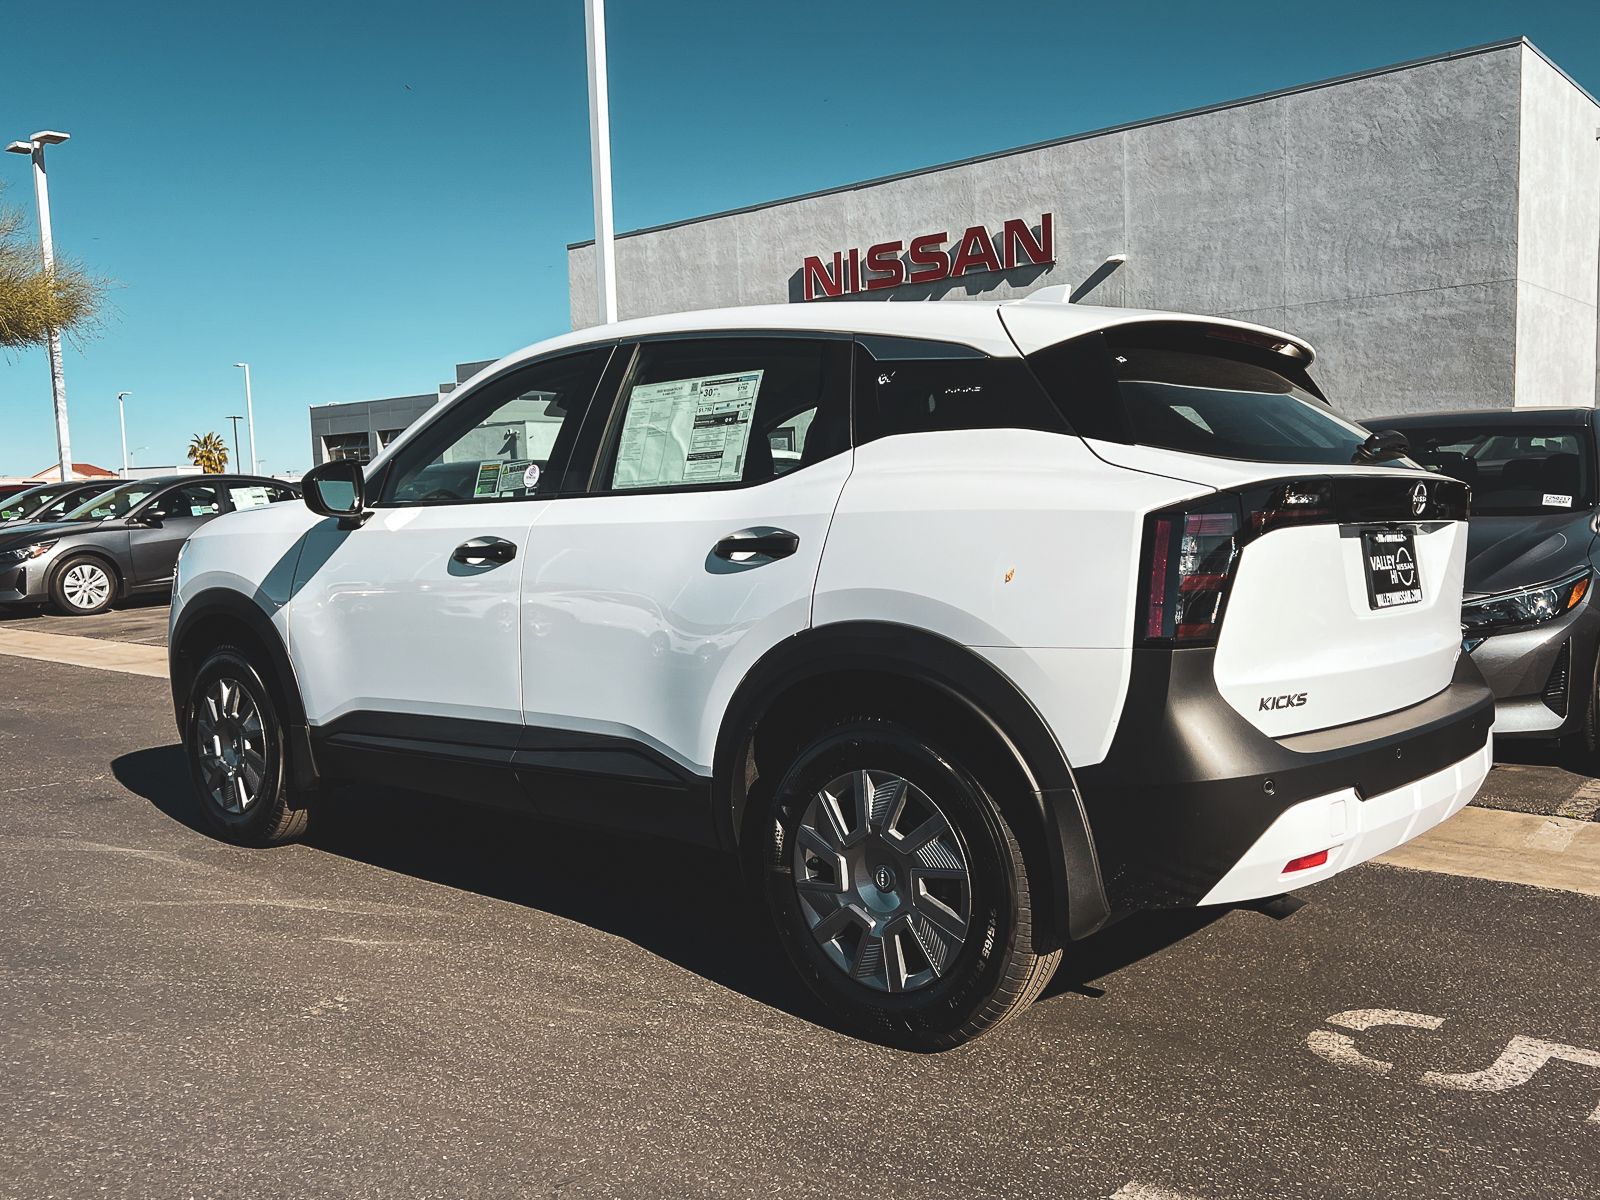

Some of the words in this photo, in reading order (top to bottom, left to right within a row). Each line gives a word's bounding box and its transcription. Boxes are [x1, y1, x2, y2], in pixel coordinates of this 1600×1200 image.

[803, 212, 1056, 300] NISSAN
[703, 388, 713, 397] 30
[1370, 555, 1395, 571] VALLEY
[1395, 562, 1415, 571] NISSAN
[1390, 569, 1399, 584] HI
[1259, 692, 1308, 711] KICKS
